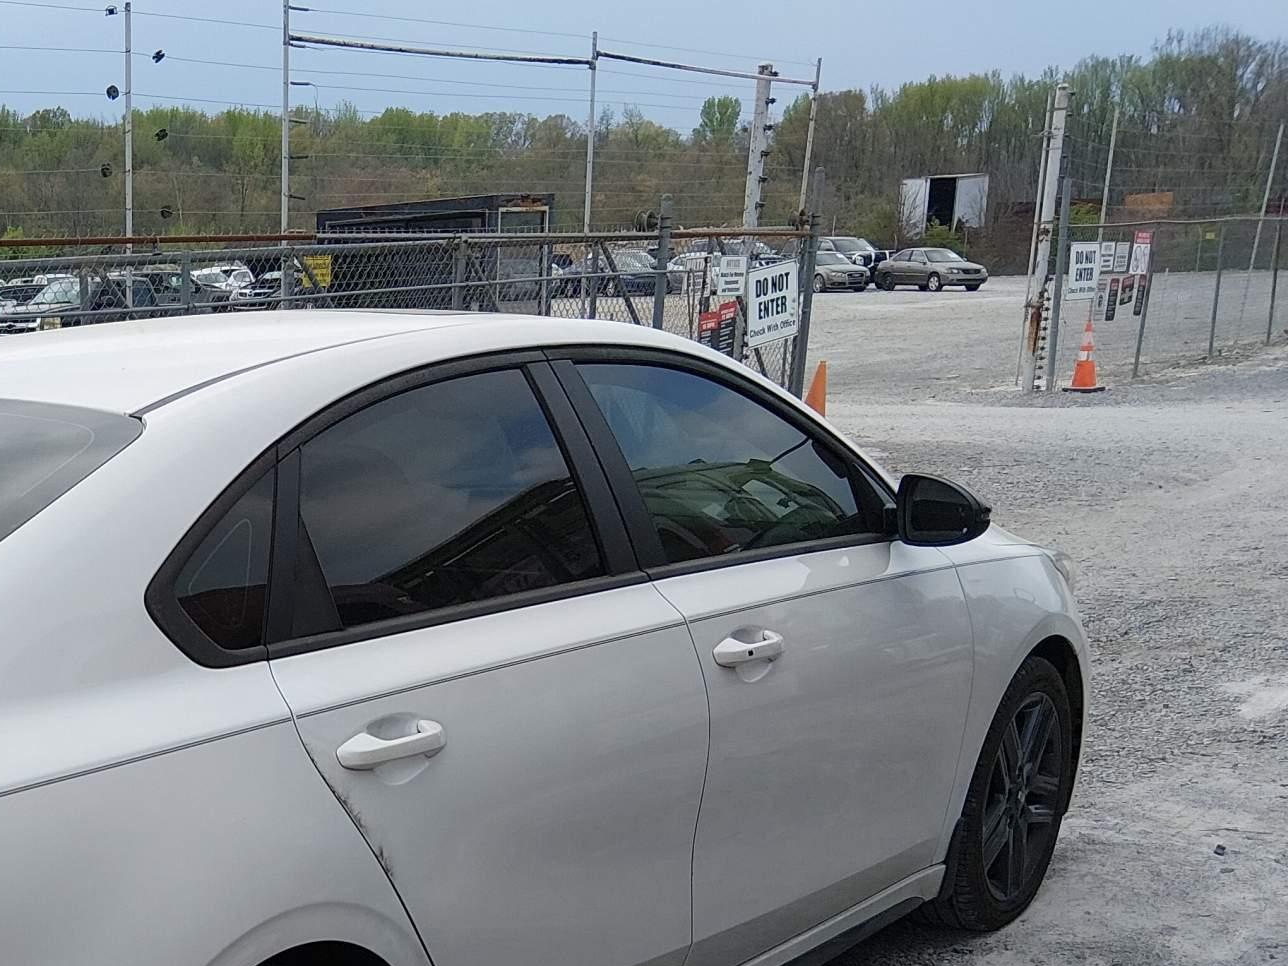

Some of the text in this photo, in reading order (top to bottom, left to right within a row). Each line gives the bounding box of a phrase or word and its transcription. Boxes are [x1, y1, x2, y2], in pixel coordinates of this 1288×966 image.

[1075, 250, 1084, 265] DO
[1084, 250, 1097, 265] NOT
[1075, 267, 1094, 282] ENTER
[755, 272, 790, 299] DO NOT
[758, 295, 787, 321] ENTER
[749, 319, 796, 338] Check With Office
